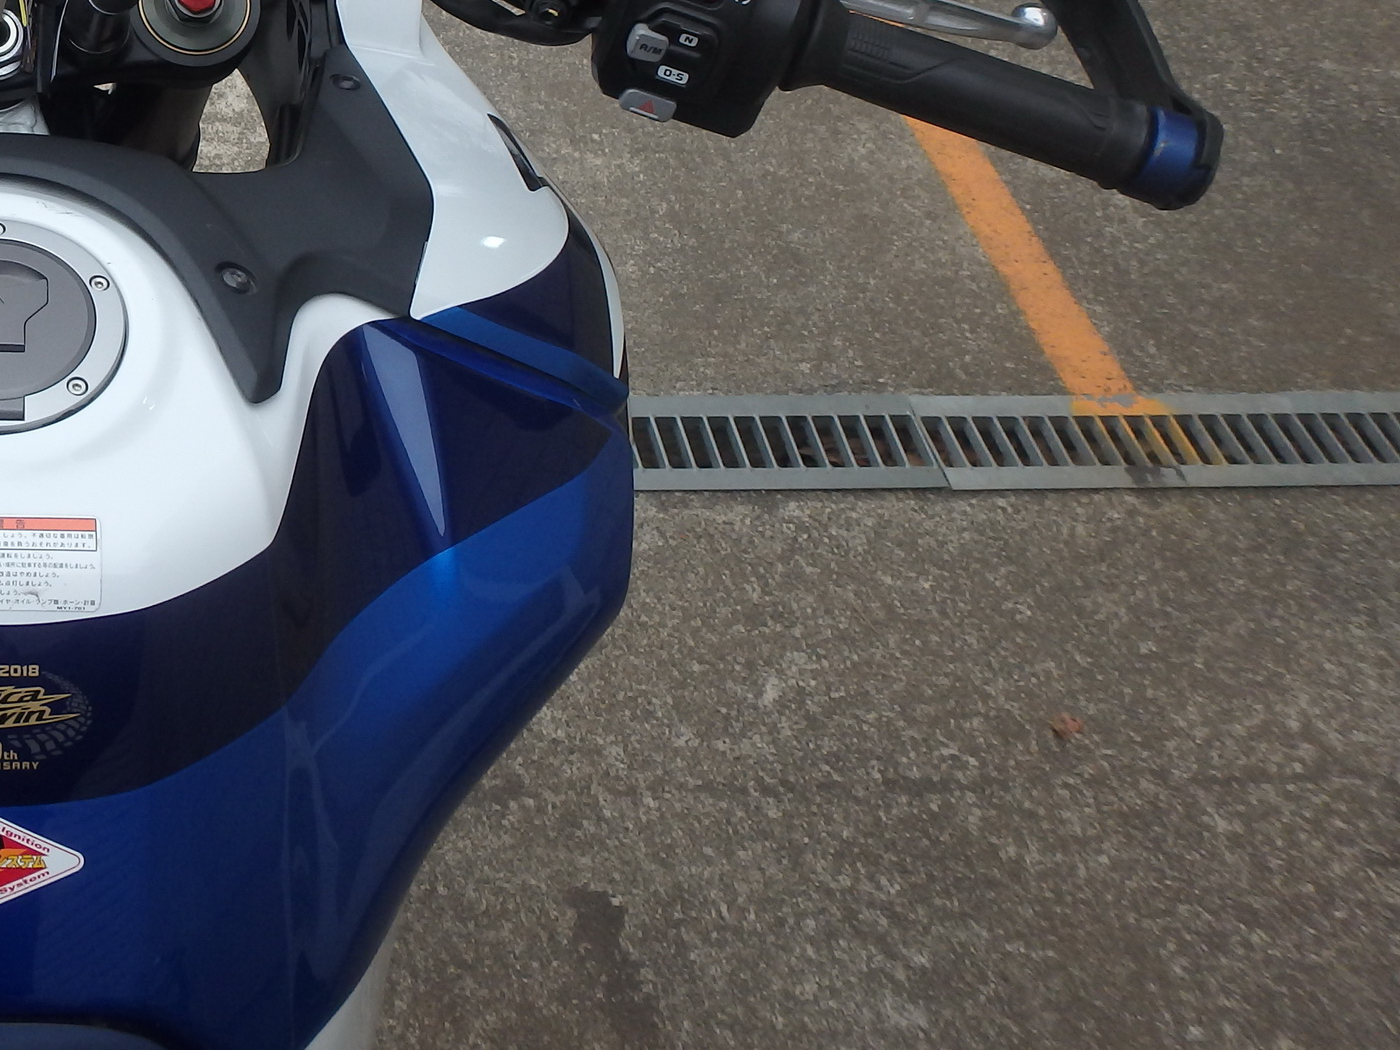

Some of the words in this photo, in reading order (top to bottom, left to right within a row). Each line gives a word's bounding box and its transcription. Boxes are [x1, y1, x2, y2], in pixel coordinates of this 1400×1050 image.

[639, 43, 663, 56] A/M
[684, 36, 694, 45] N
[1, 826, 51, 854] Ignition
[0, 870, 51, 895] System
